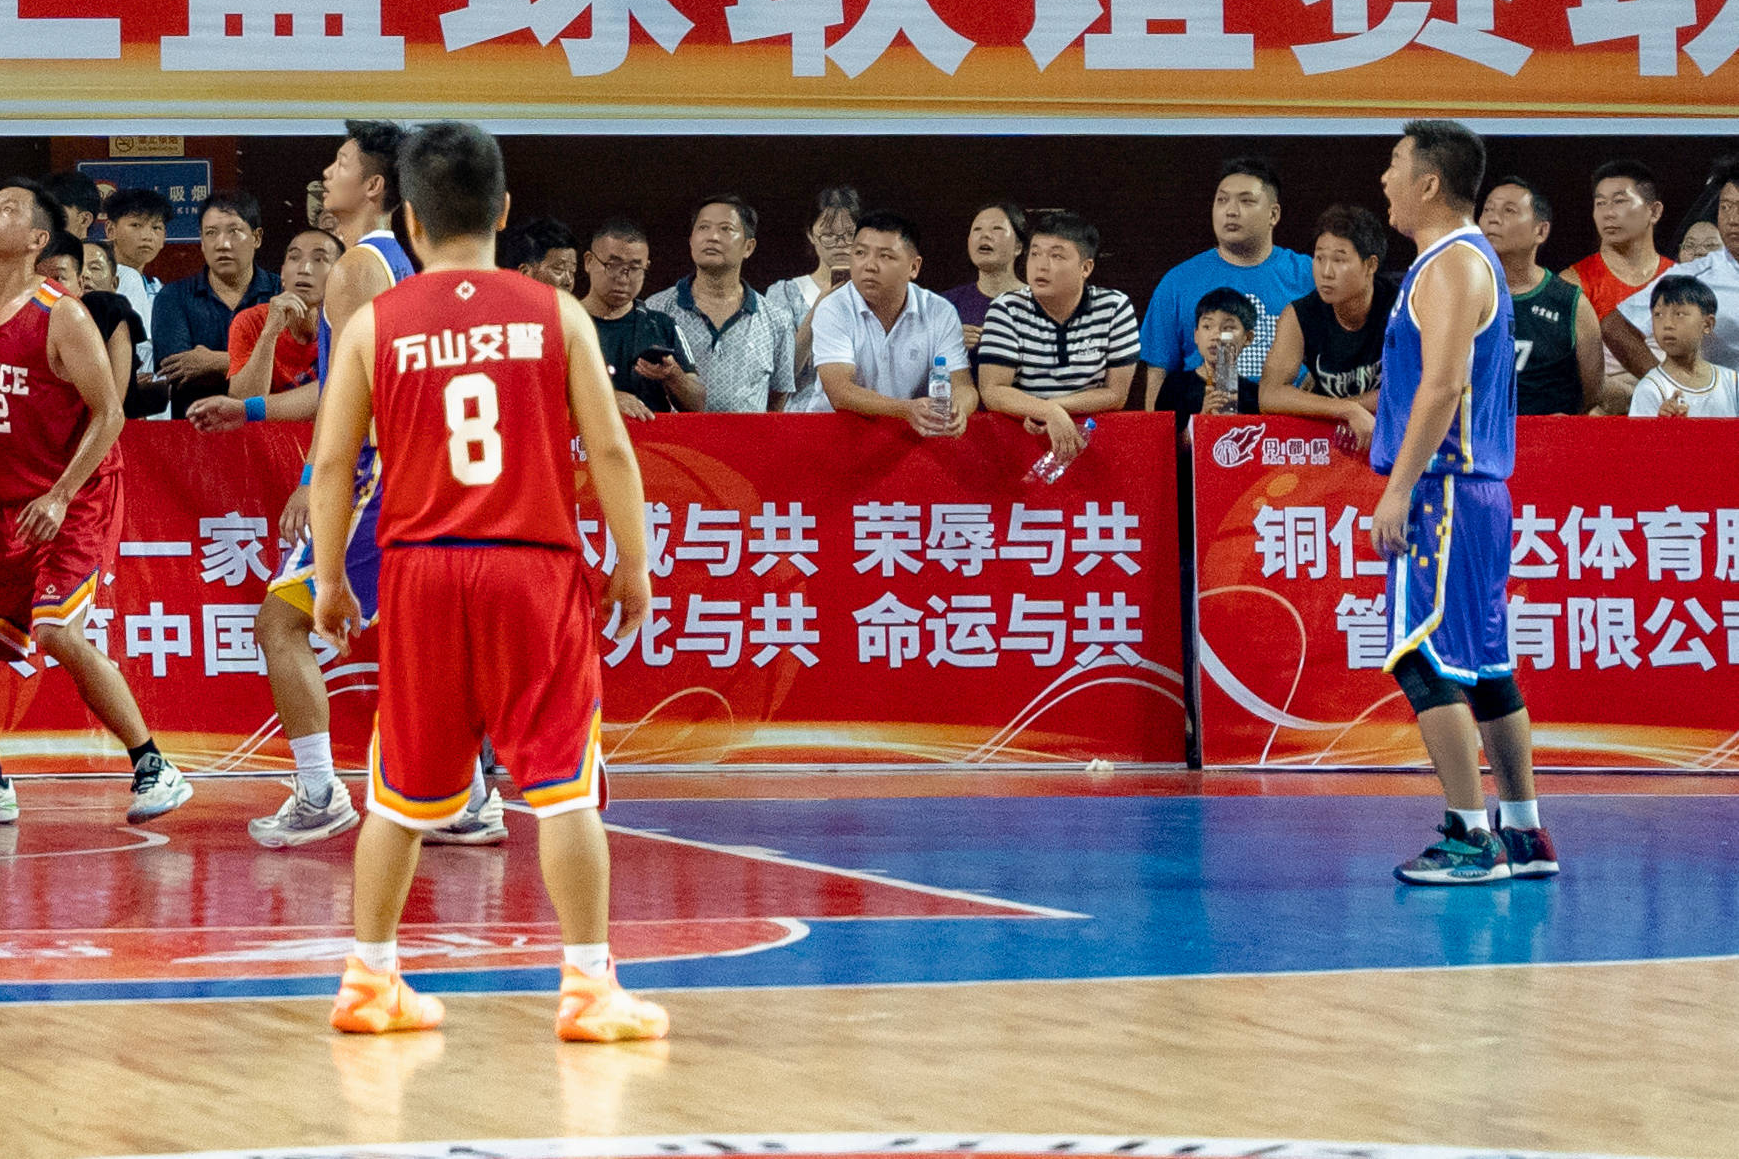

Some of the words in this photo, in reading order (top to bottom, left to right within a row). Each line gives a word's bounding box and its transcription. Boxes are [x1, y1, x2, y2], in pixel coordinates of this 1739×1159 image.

[392, 322, 545, 375] 万山交警
[443, 372, 504, 486] 8
[852, 501, 1142, 578] 荣辱与共
[1253, 504, 1739, 583] 铜仁达体育
[600, 593, 821, 668] 死与共
[851, 591, 1144, 670] 命运与共
[1335, 593, 1739, 673] 管有限公
